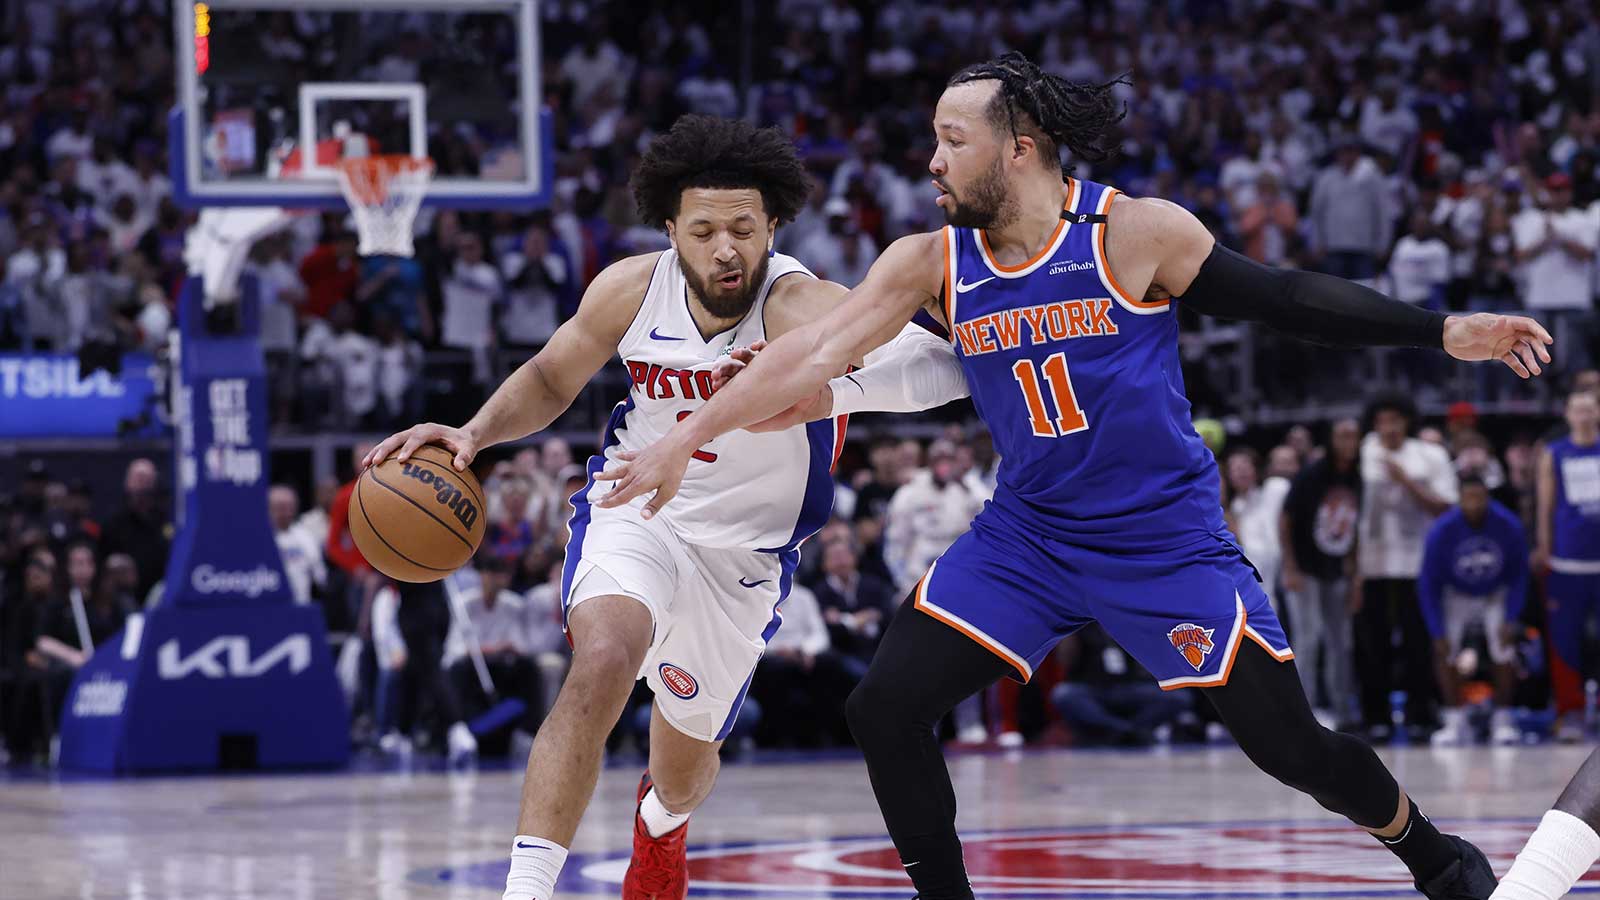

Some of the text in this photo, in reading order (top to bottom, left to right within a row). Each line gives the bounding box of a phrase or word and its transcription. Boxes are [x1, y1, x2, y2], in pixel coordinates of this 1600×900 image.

[1049, 266, 1067, 276] abu
[1067, 260, 1095, 272] dhabi
[1012, 351, 1090, 438] 11
[402, 462, 478, 532] Wilson
[191, 564, 280, 599] Google
